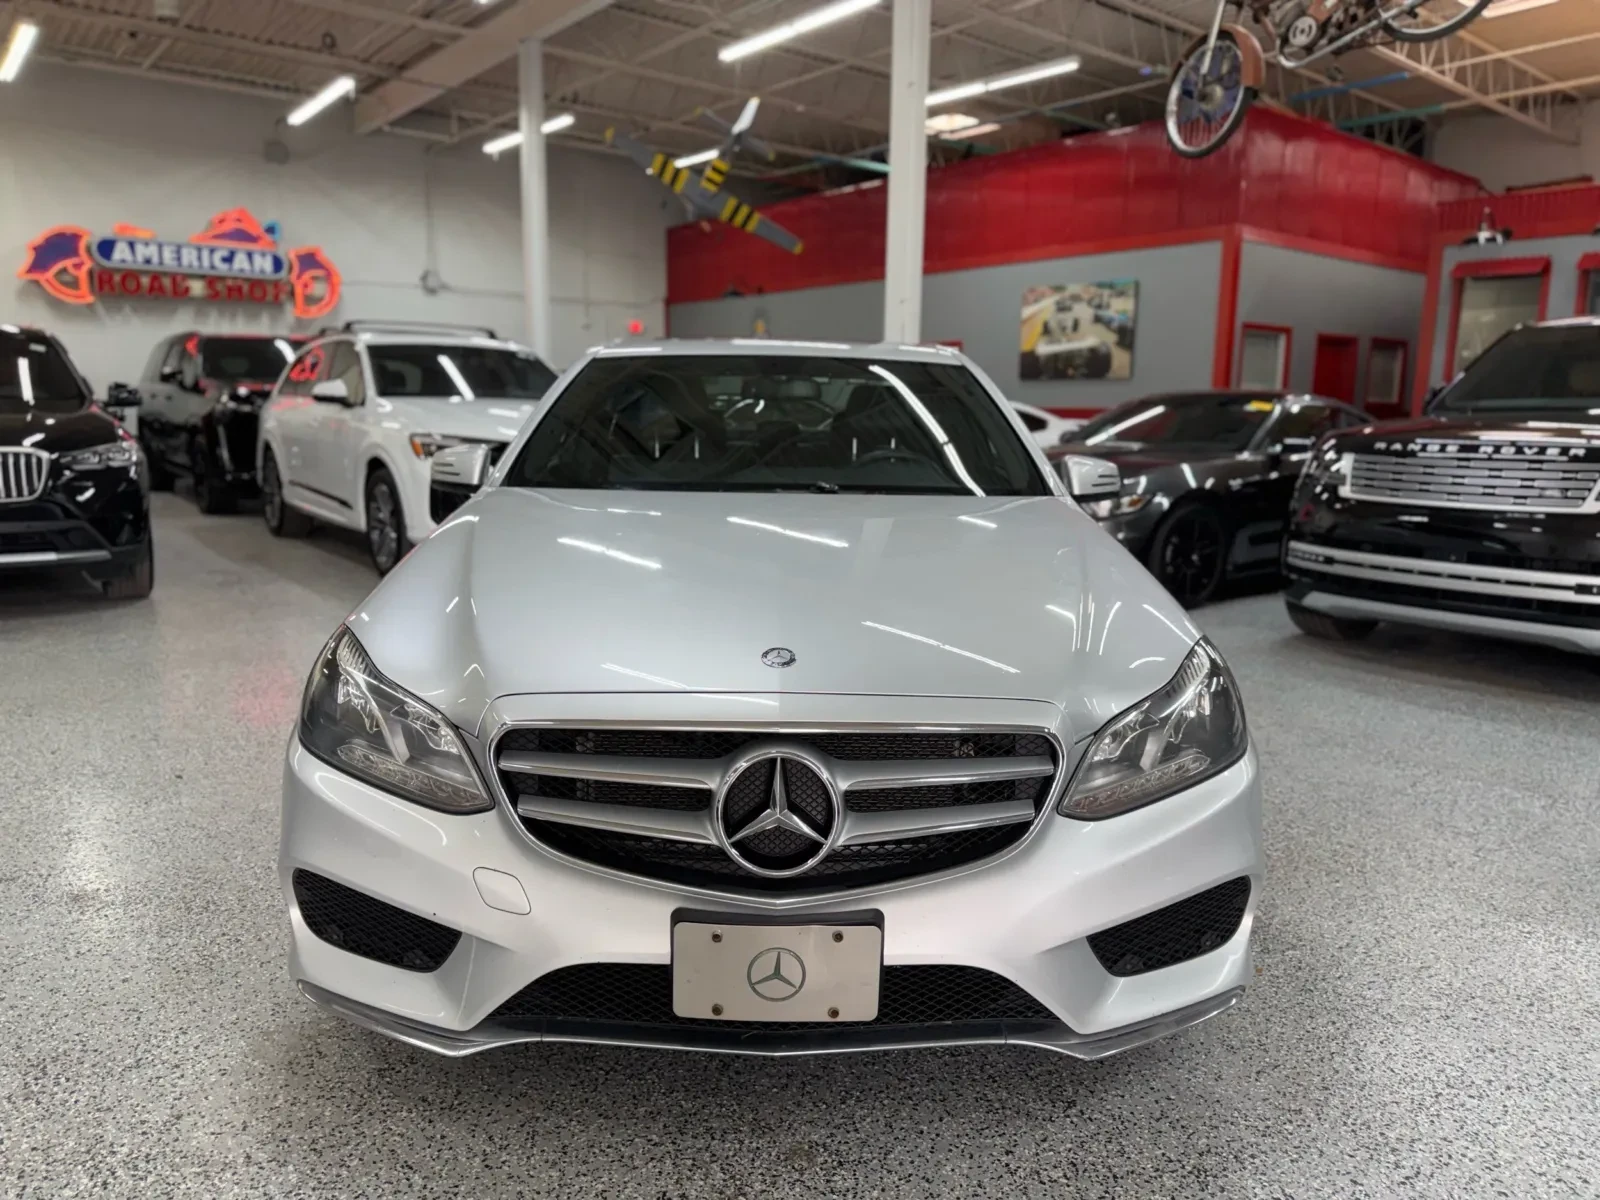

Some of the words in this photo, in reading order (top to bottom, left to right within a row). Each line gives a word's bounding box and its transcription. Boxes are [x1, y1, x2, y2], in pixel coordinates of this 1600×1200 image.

[110, 240, 275, 274] AMERICAN
[97, 269, 191, 299] ROAD
[1373, 441, 1460, 453] RANGE
[1478, 445, 1587, 457] ROVER
